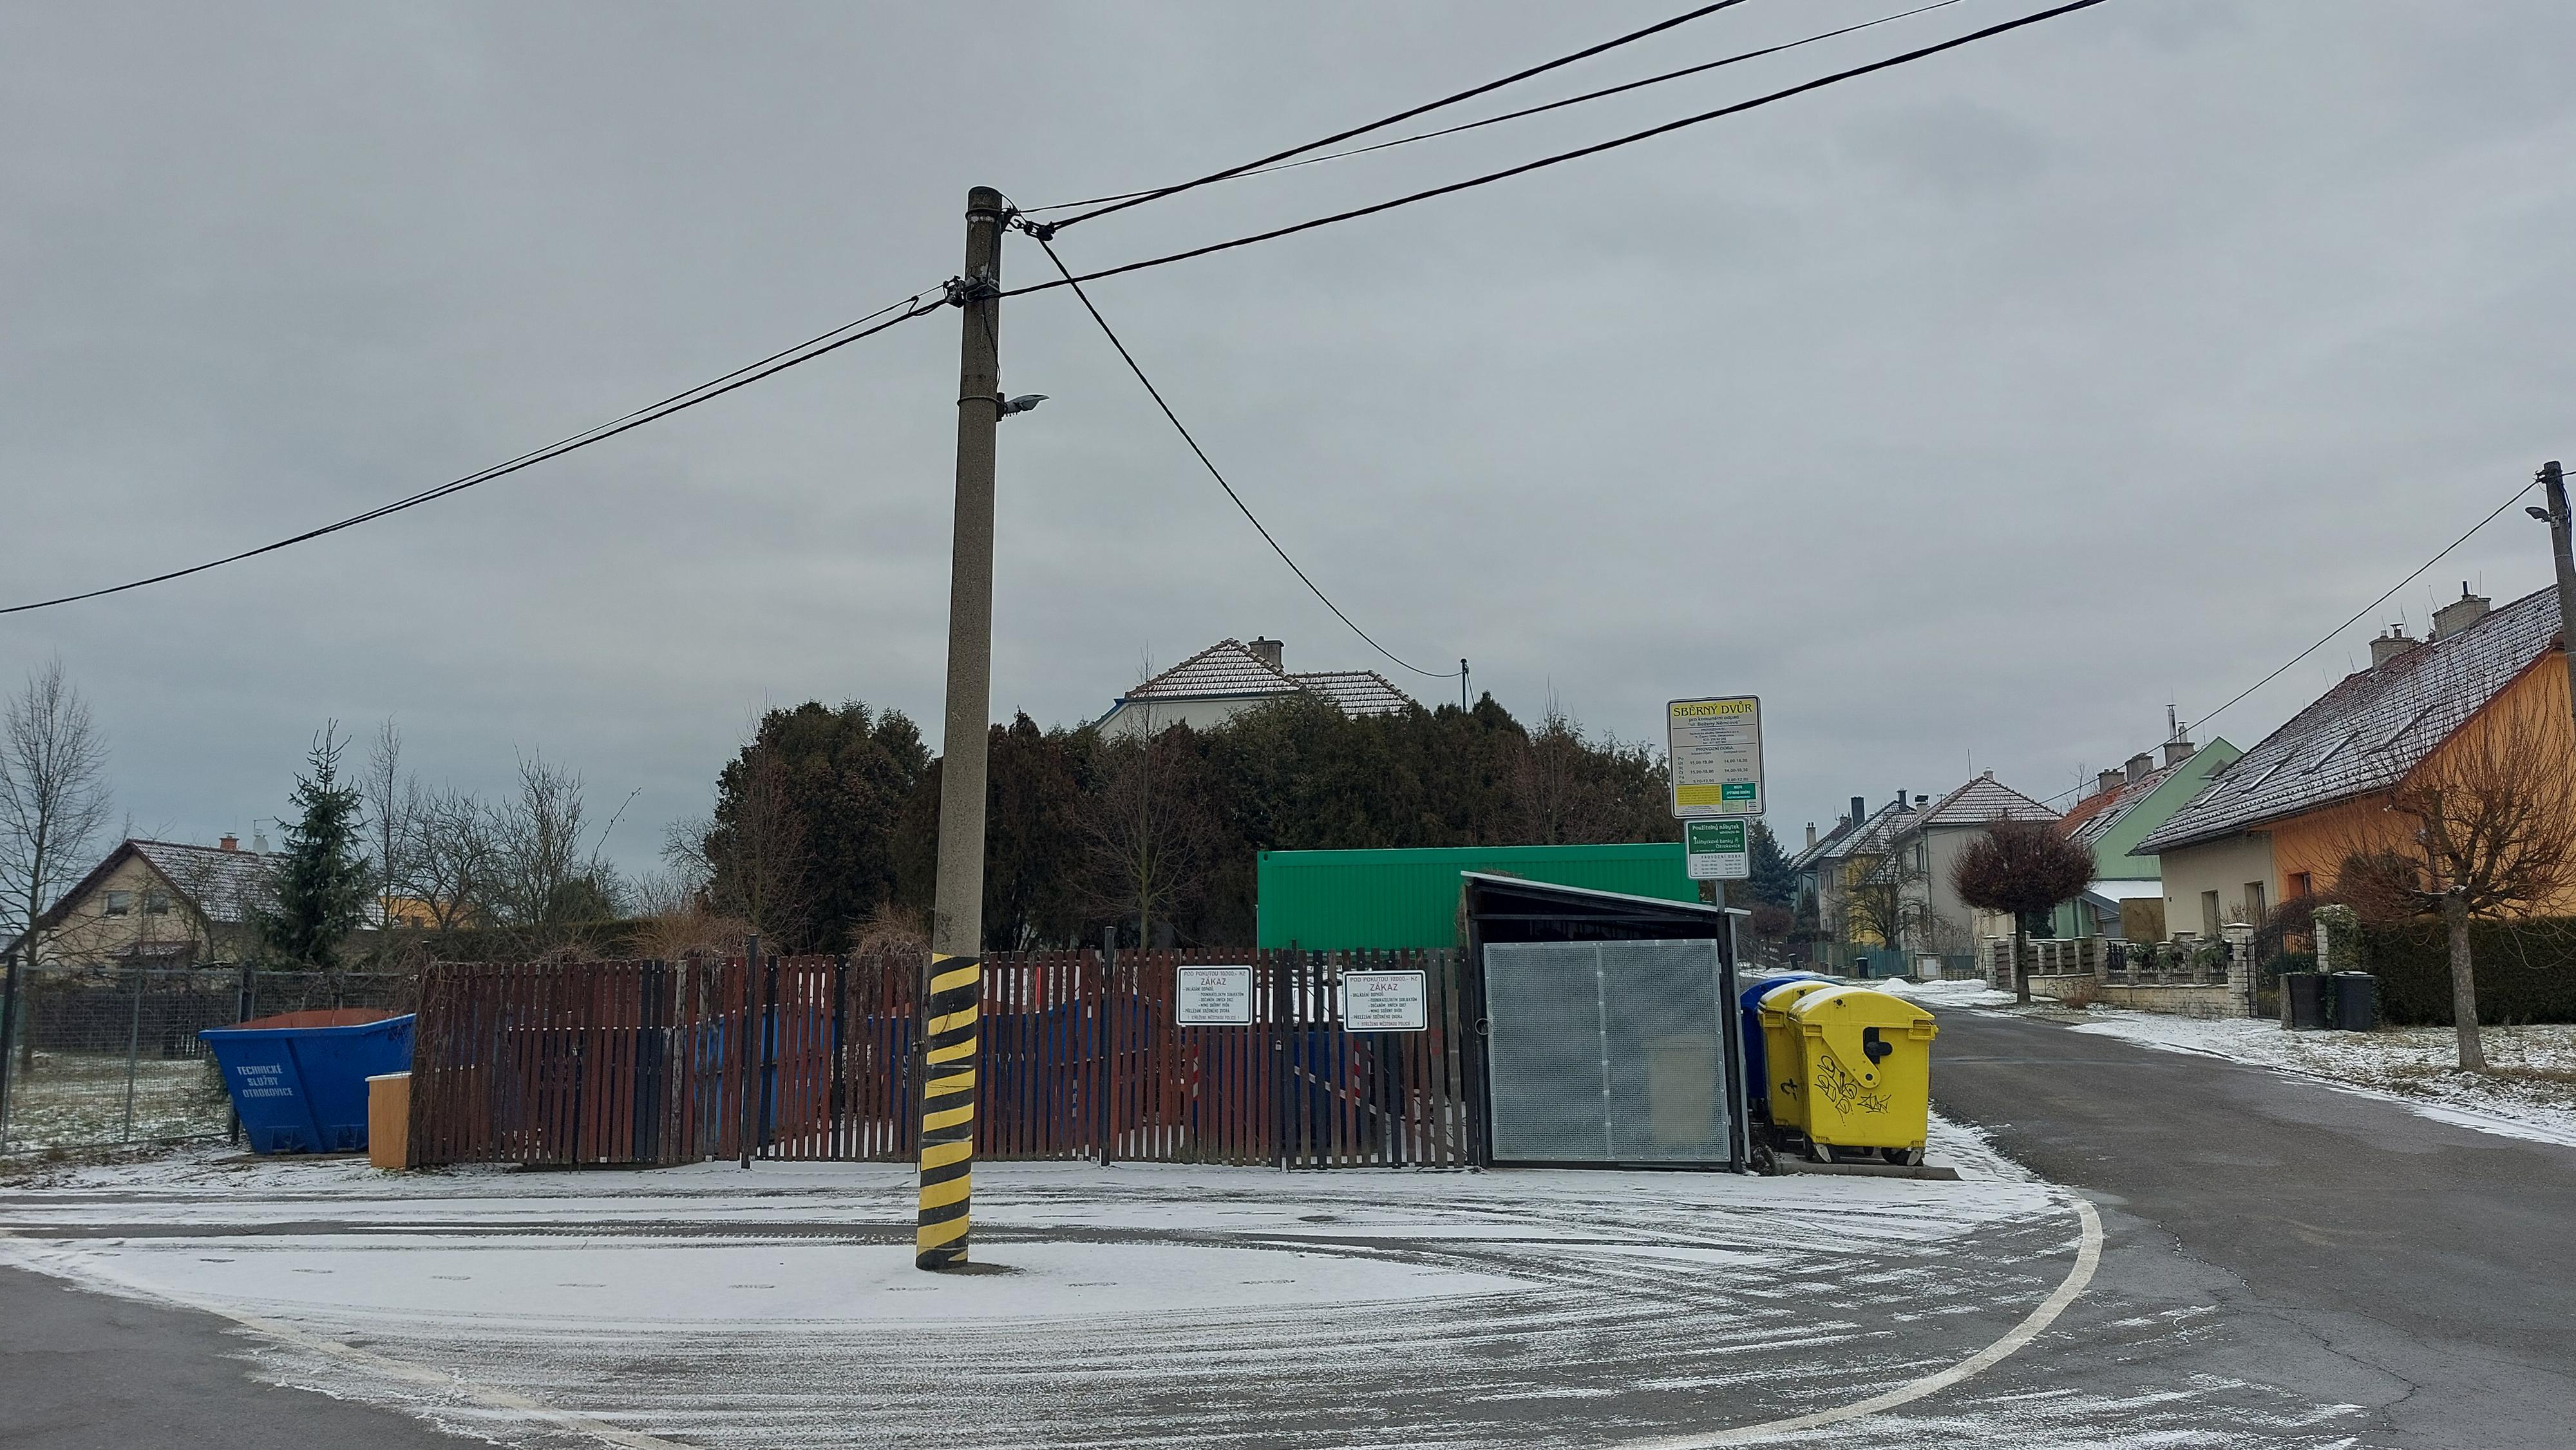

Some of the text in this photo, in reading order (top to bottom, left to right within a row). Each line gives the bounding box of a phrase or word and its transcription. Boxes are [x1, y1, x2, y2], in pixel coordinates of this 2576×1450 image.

[1674, 701, 1752, 716] SBĚRNÝ DVŮR
[1201, 976, 1226, 986] ZÁKAZ
[1370, 982, 1398, 992] ZÁKAZ
[236, 1063, 283, 1075] TECHNICKÉ
[247, 1075, 278, 1086] SLUŽBY
[242, 1088, 294, 1098] OTROKOVICE
